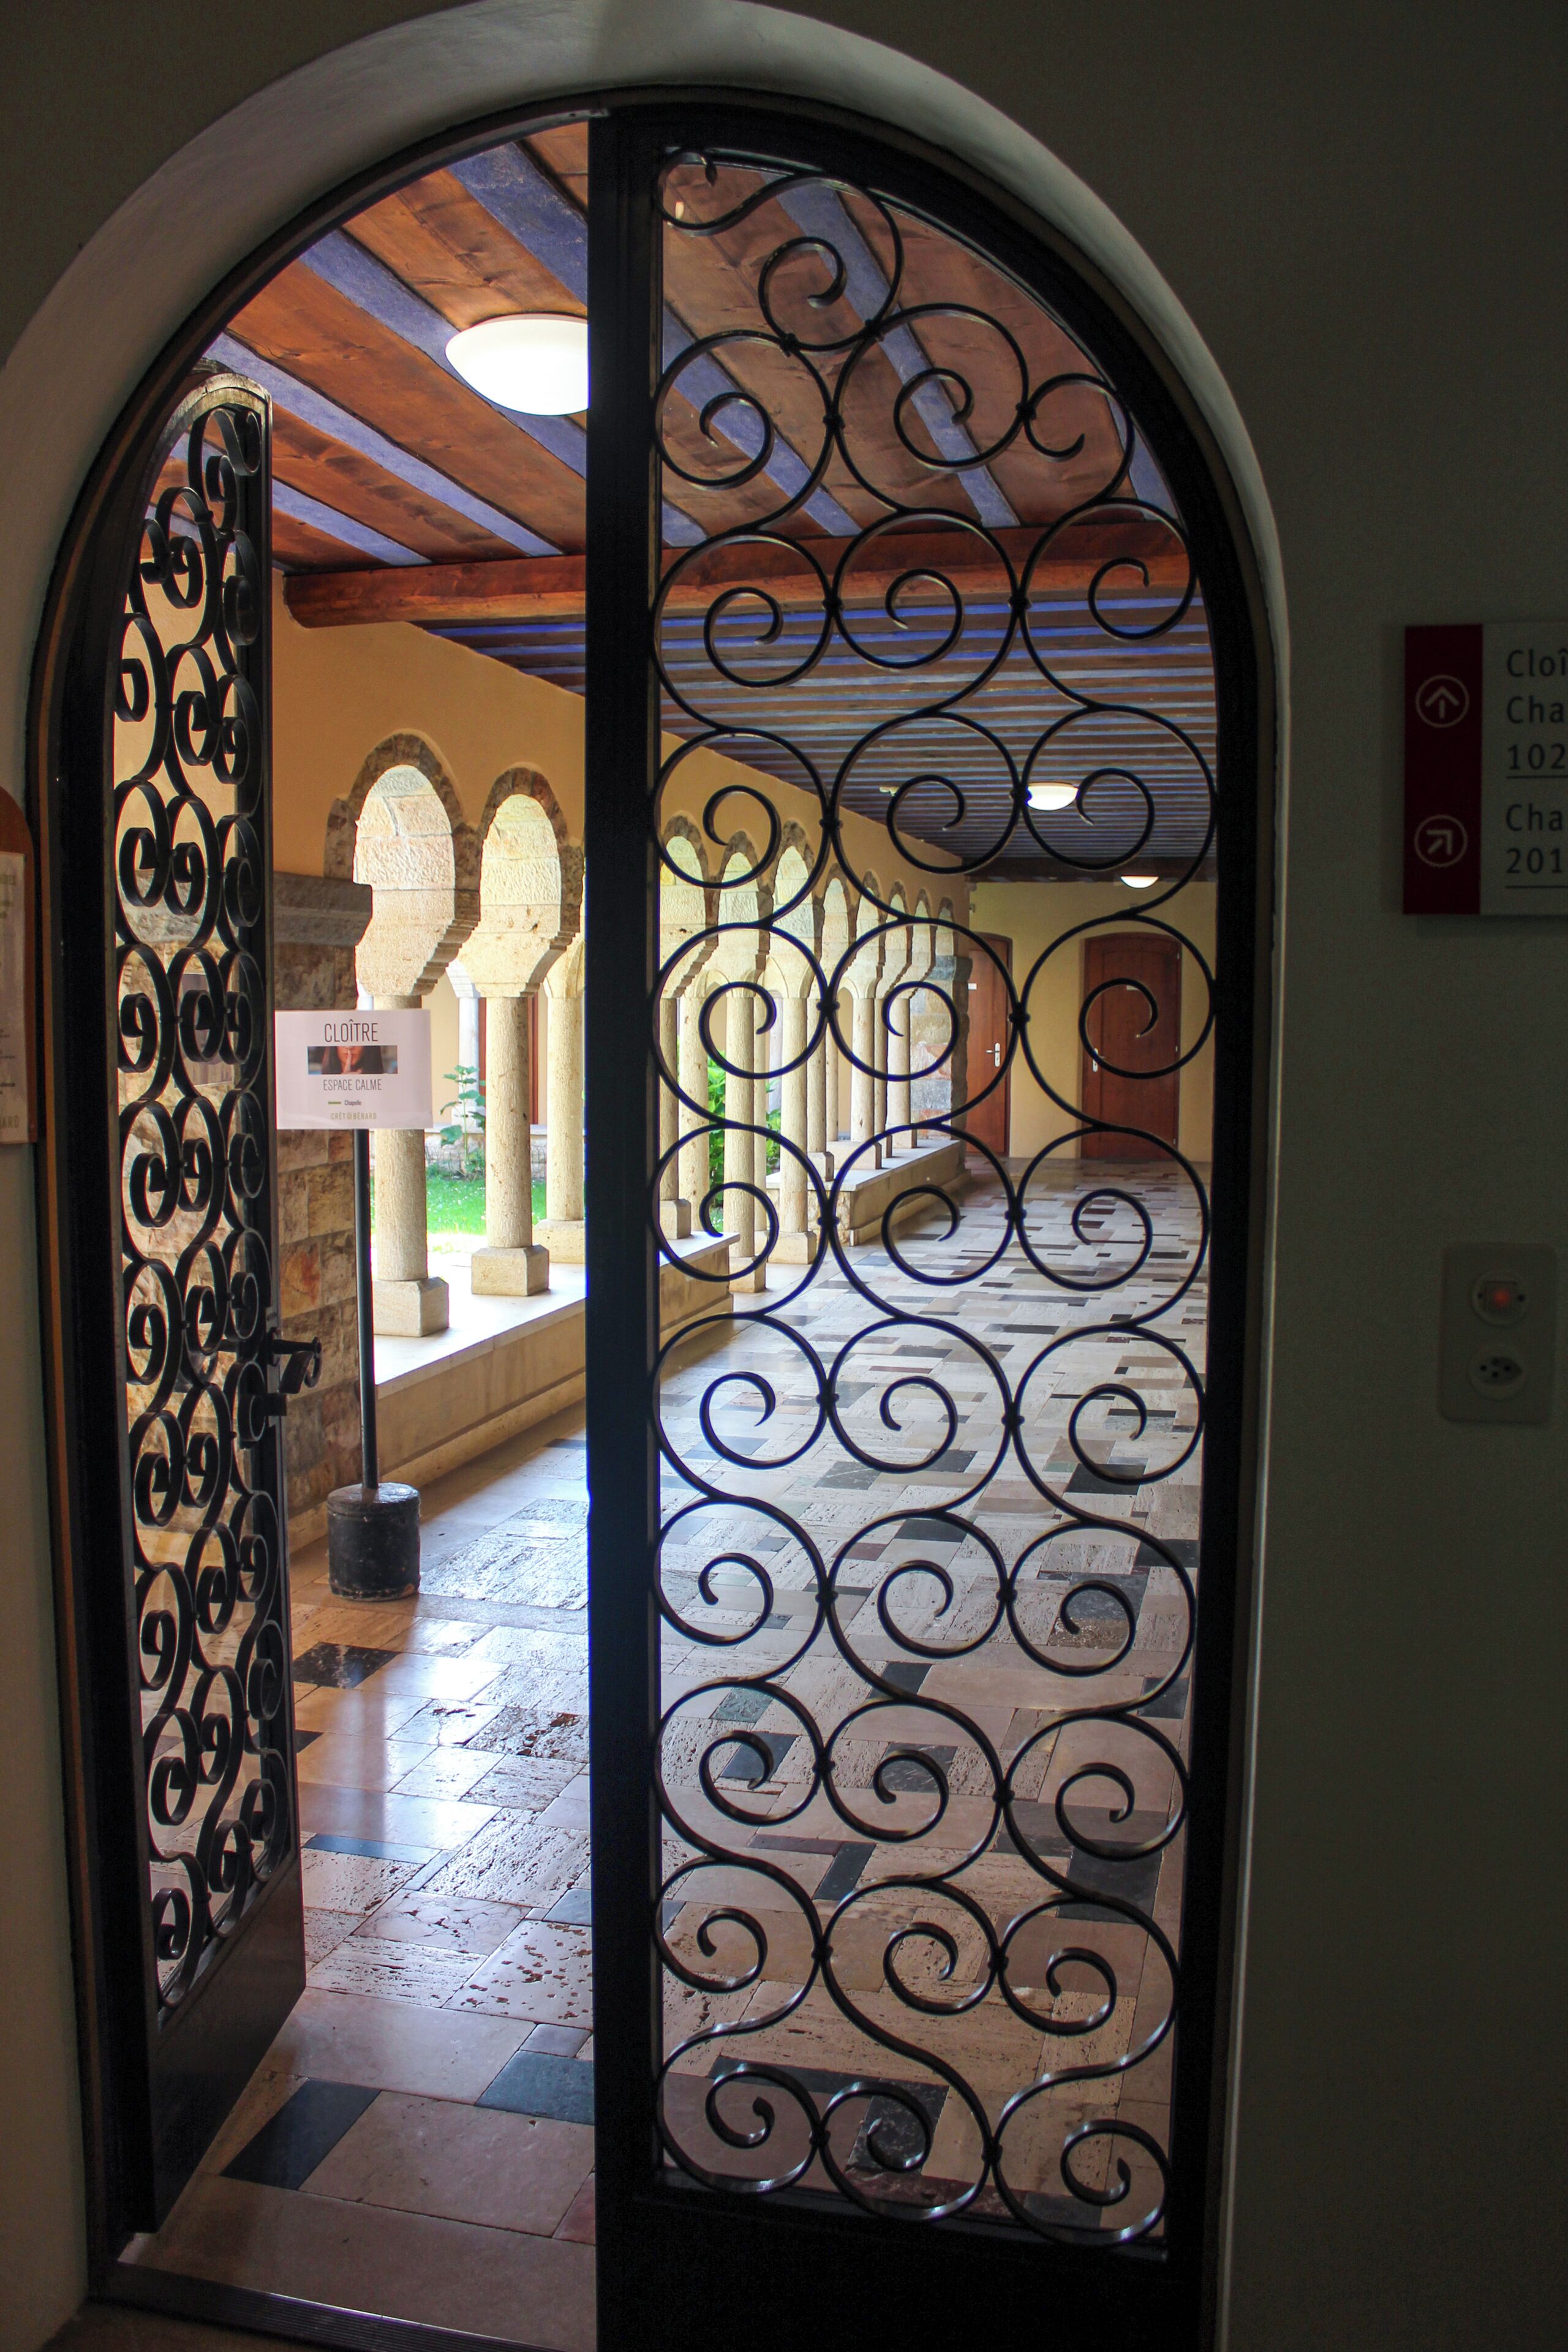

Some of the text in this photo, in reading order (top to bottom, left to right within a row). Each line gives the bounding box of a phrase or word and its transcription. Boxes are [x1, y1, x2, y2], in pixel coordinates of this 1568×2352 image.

[1506, 695, 1564, 725] Cha
[1508, 743, 1566, 771] 102
[1505, 802, 1563, 832] Cha
[1506, 847, 1562, 874] 201
[324, 1019, 379, 1042] CLOÎTRE
[323, 1079, 382, 1091] ESPACE CALME
